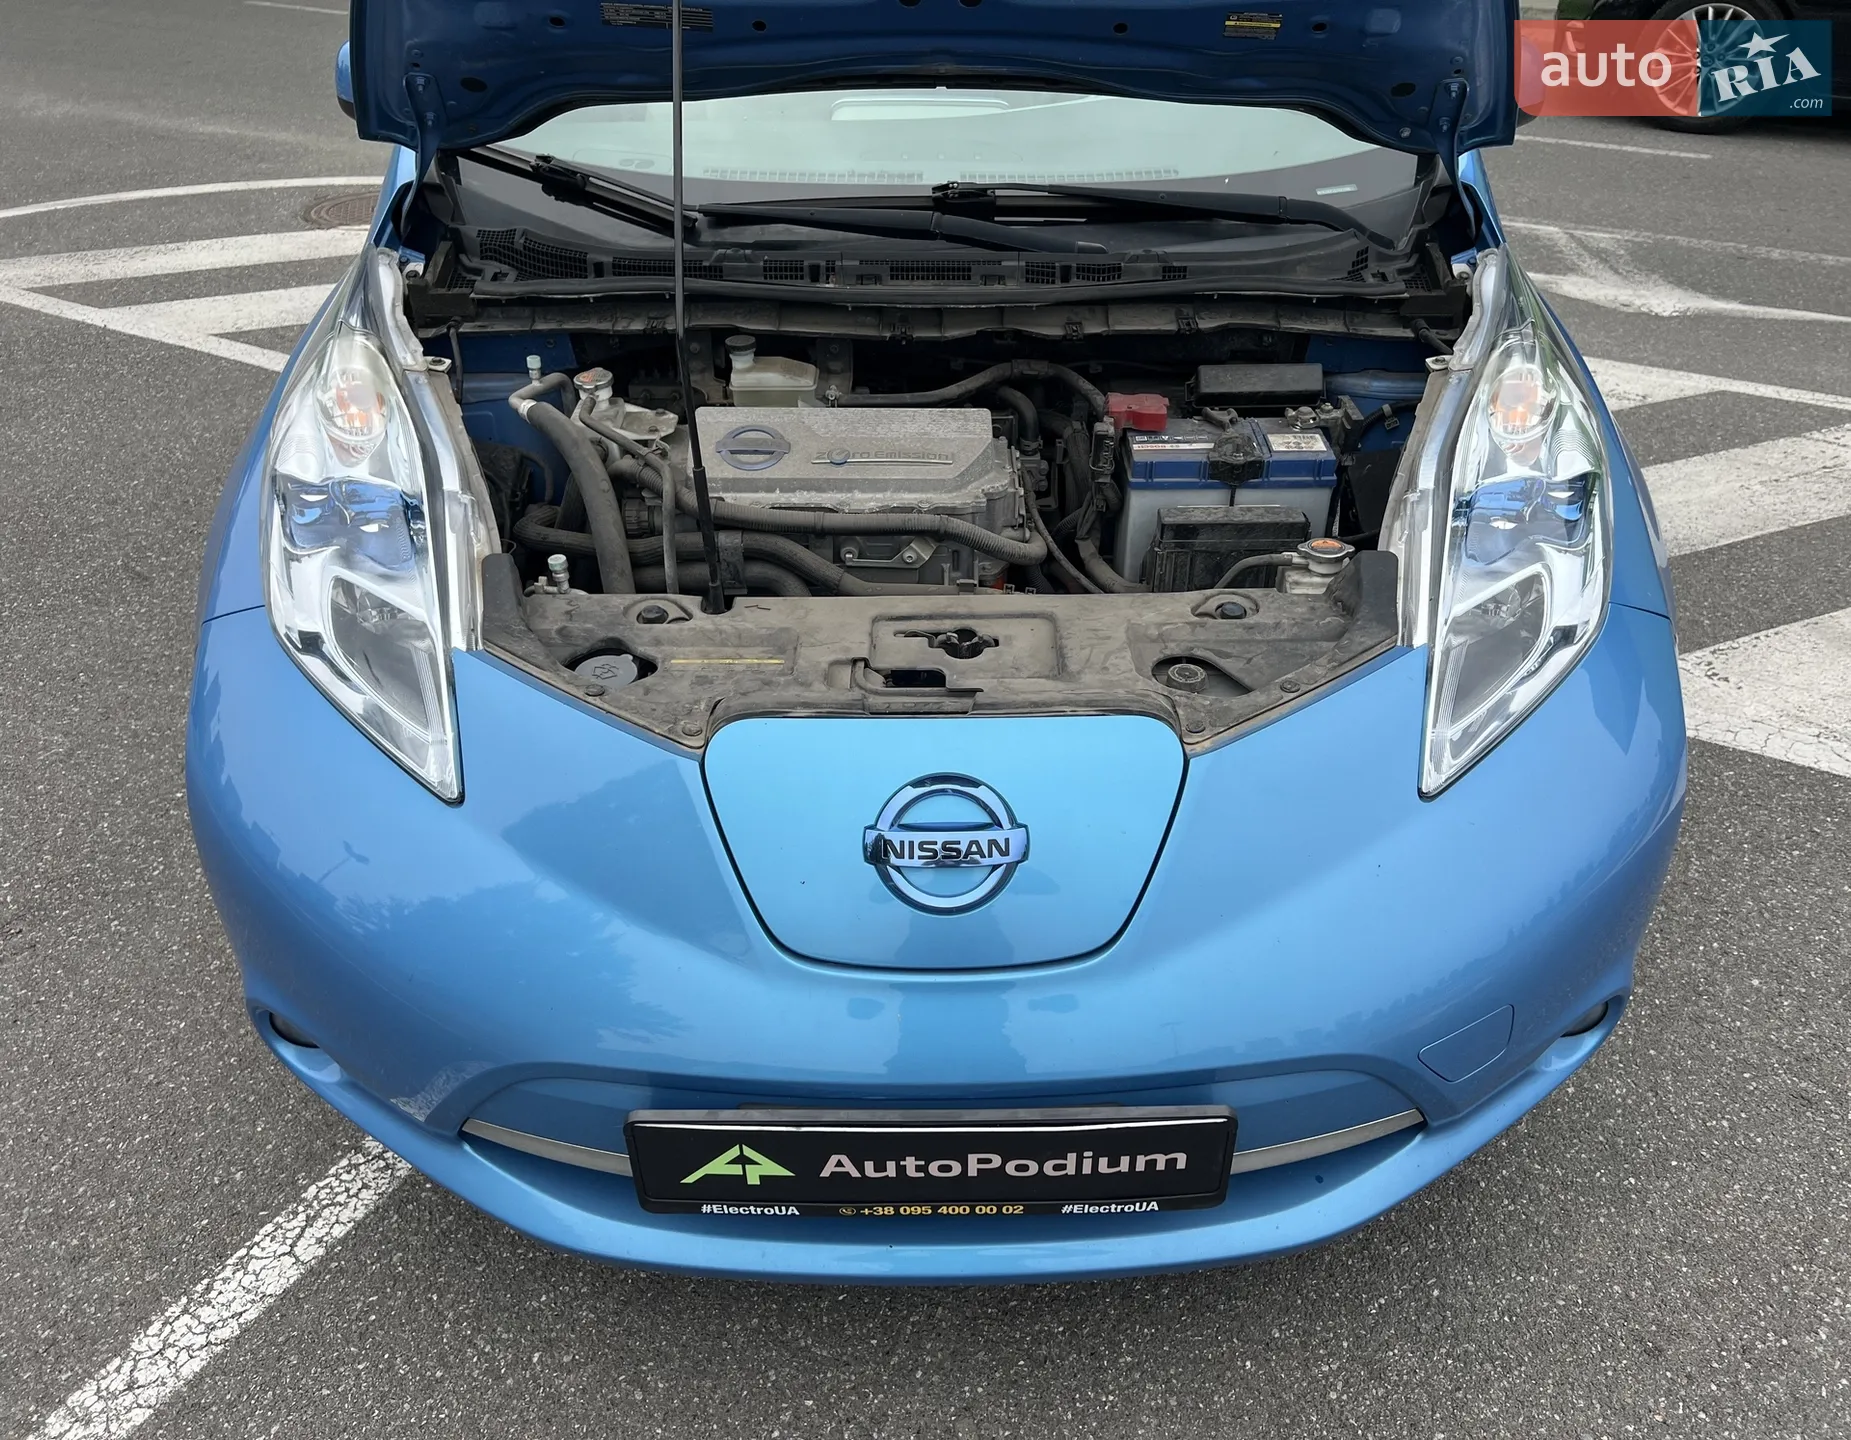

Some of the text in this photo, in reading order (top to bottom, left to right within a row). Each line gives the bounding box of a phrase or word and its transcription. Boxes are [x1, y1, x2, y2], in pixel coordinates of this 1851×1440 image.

[881, 837, 1010, 860] NISSAN
[819, 1151, 1187, 1178] AutoPodium
[700, 1204, 800, 1216] #ElectroUA
[860, 1205, 1024, 1215] +38 095 400 00 02
[1061, 1201, 1159, 1214] #ElectroUA
